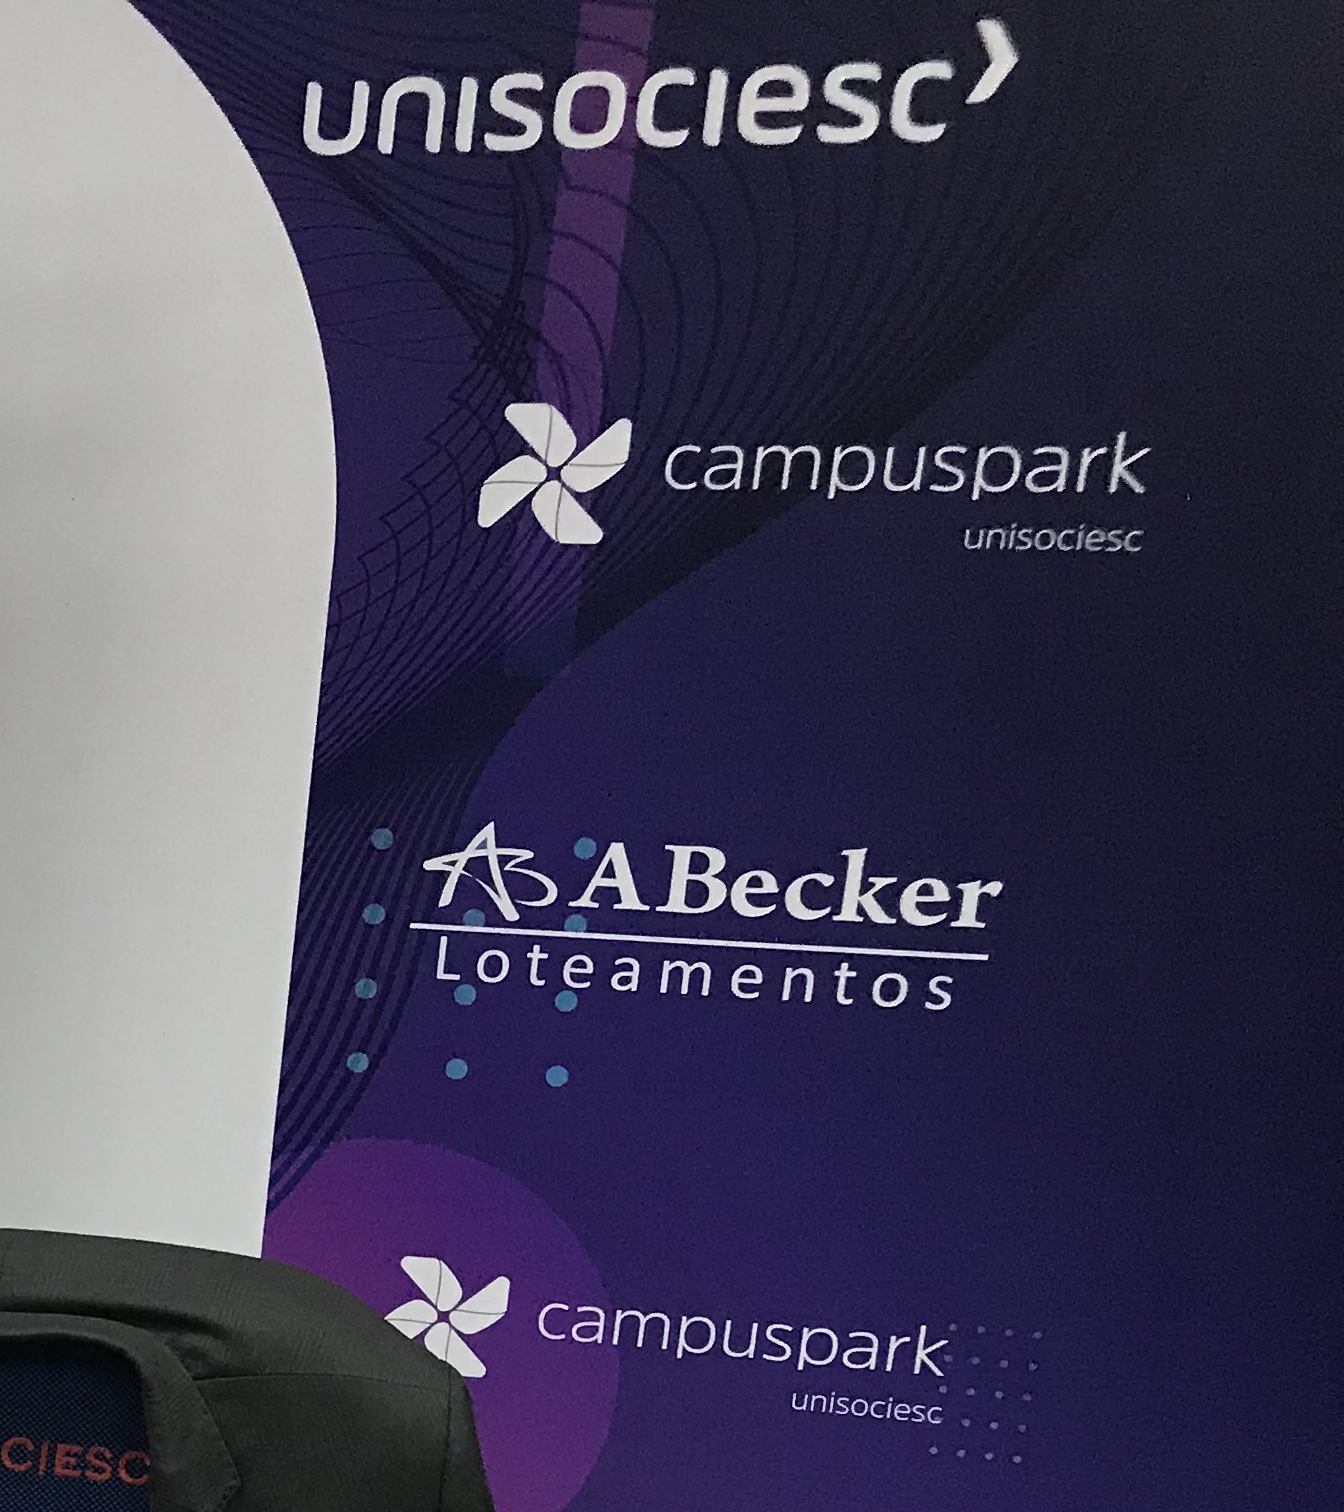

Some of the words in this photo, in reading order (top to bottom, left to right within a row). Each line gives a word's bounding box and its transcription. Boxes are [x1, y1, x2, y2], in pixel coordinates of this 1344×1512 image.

[662, 430, 1152, 501] campuspark
[961, 521, 1144, 554] unisociesc
[434, 934, 956, 1011] Loteamentos
[536, 1298, 950, 1378] campuspark
[790, 1388, 944, 1426] unisociesc
